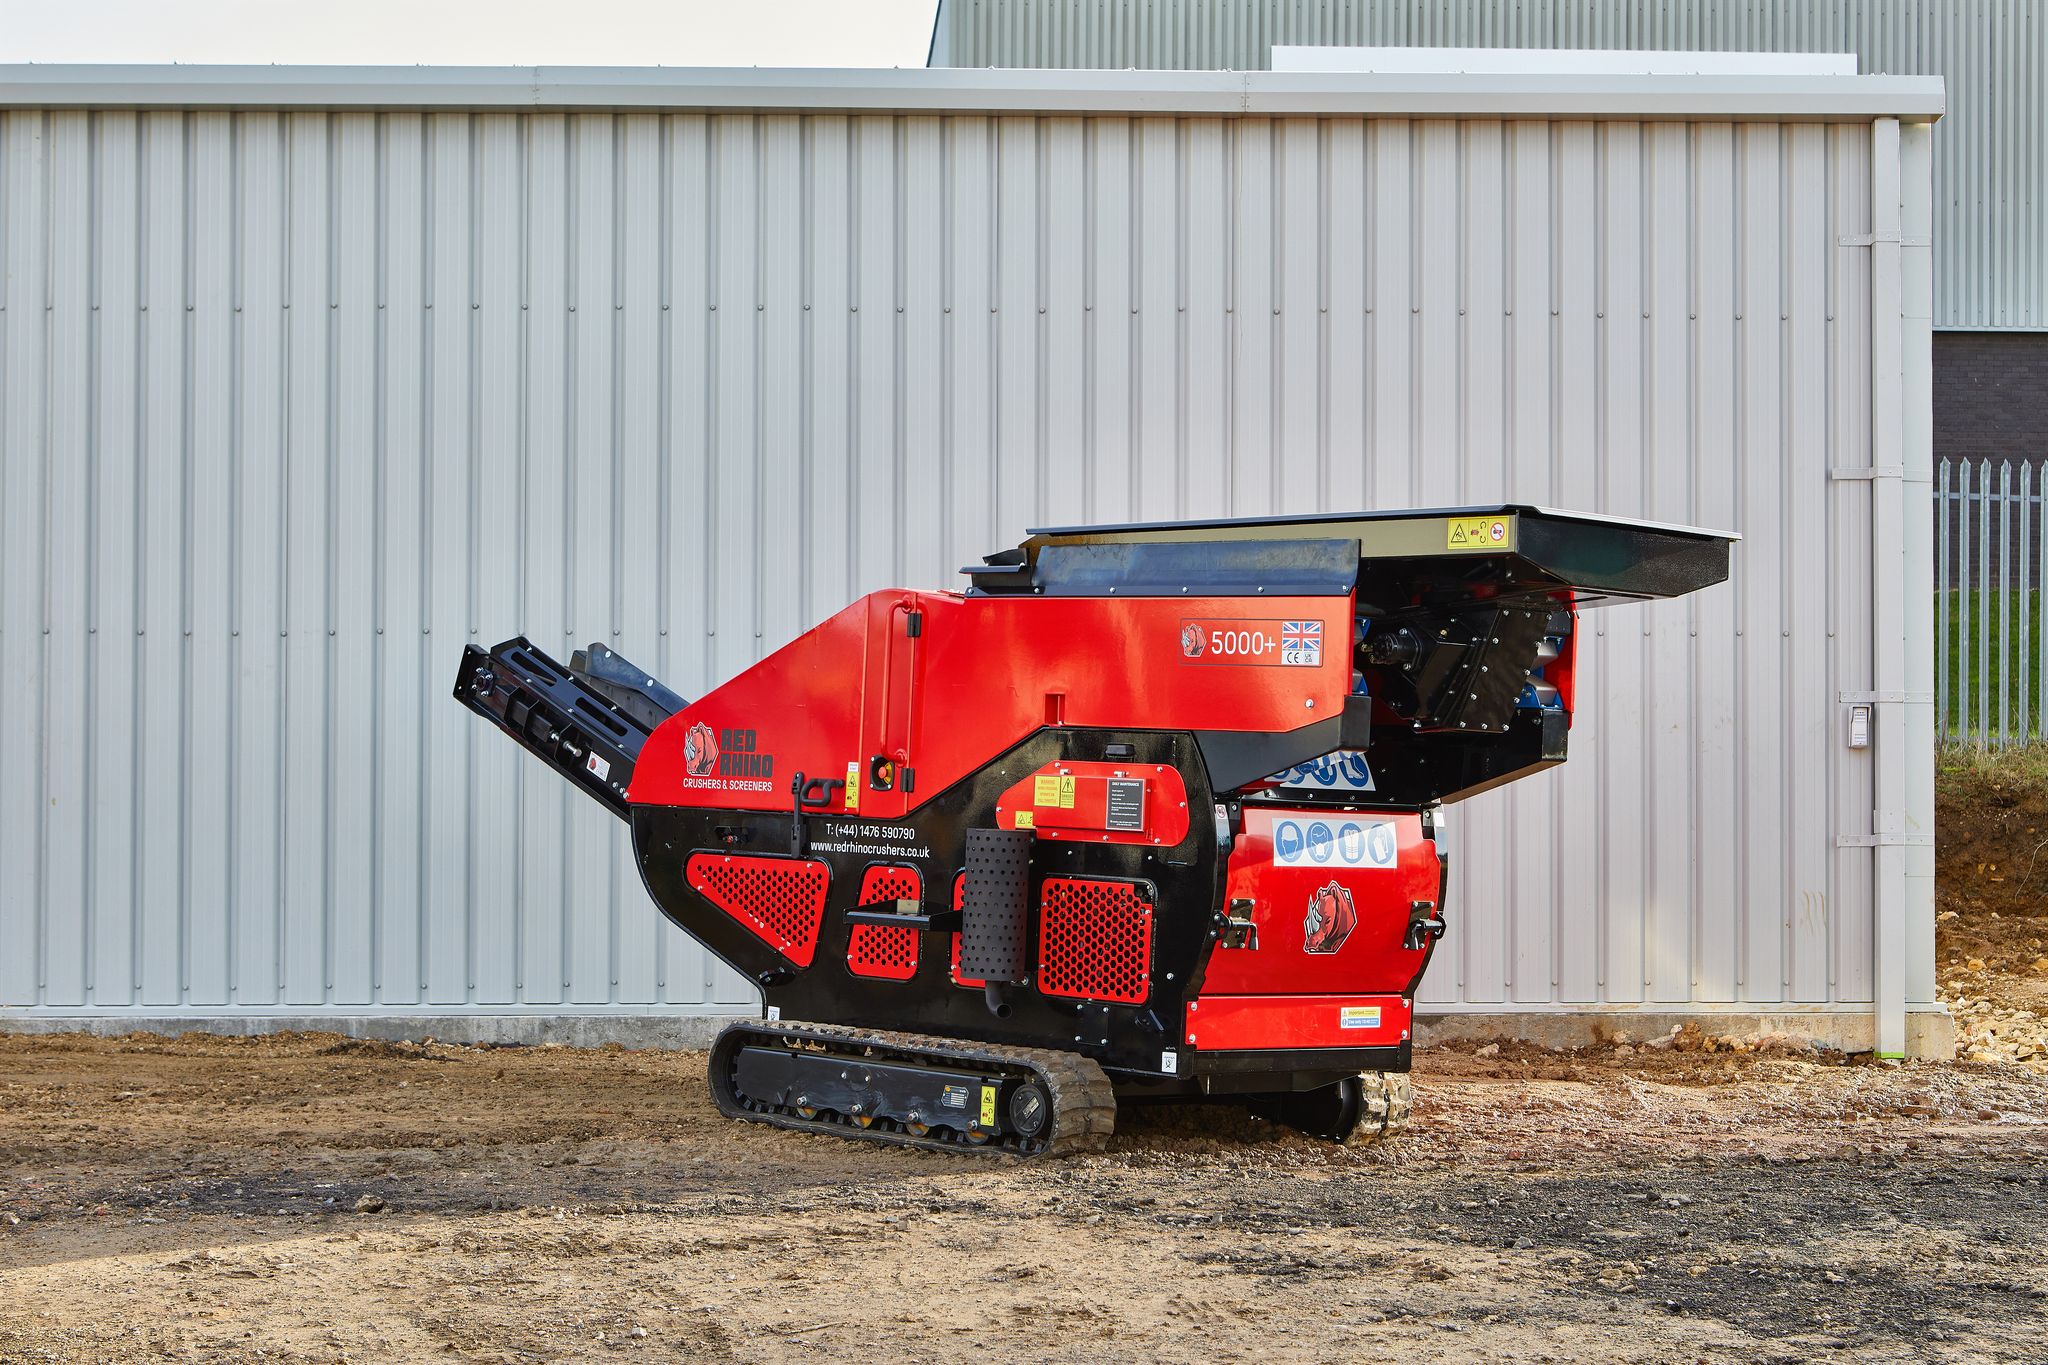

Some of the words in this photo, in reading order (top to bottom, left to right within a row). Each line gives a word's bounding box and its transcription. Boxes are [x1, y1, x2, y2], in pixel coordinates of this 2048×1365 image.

[1211, 631, 1276, 655] 5000+
[1287, 652, 1299, 664] CE
[721, 728, 757, 752] RED
[720, 753, 773, 778] RHINO
[683, 778, 721, 790] CRUSHERS
[722, 779, 728, 790] &
[729, 780, 773, 792] SCREENERS
[826, 823, 834, 835] T:
[835, 823, 858, 838] (+44)
[860, 825, 880, 838] 1476
[882, 826, 915, 840] 590790
[810, 841, 930, 858] www.redrhinocrushers.co.uk
